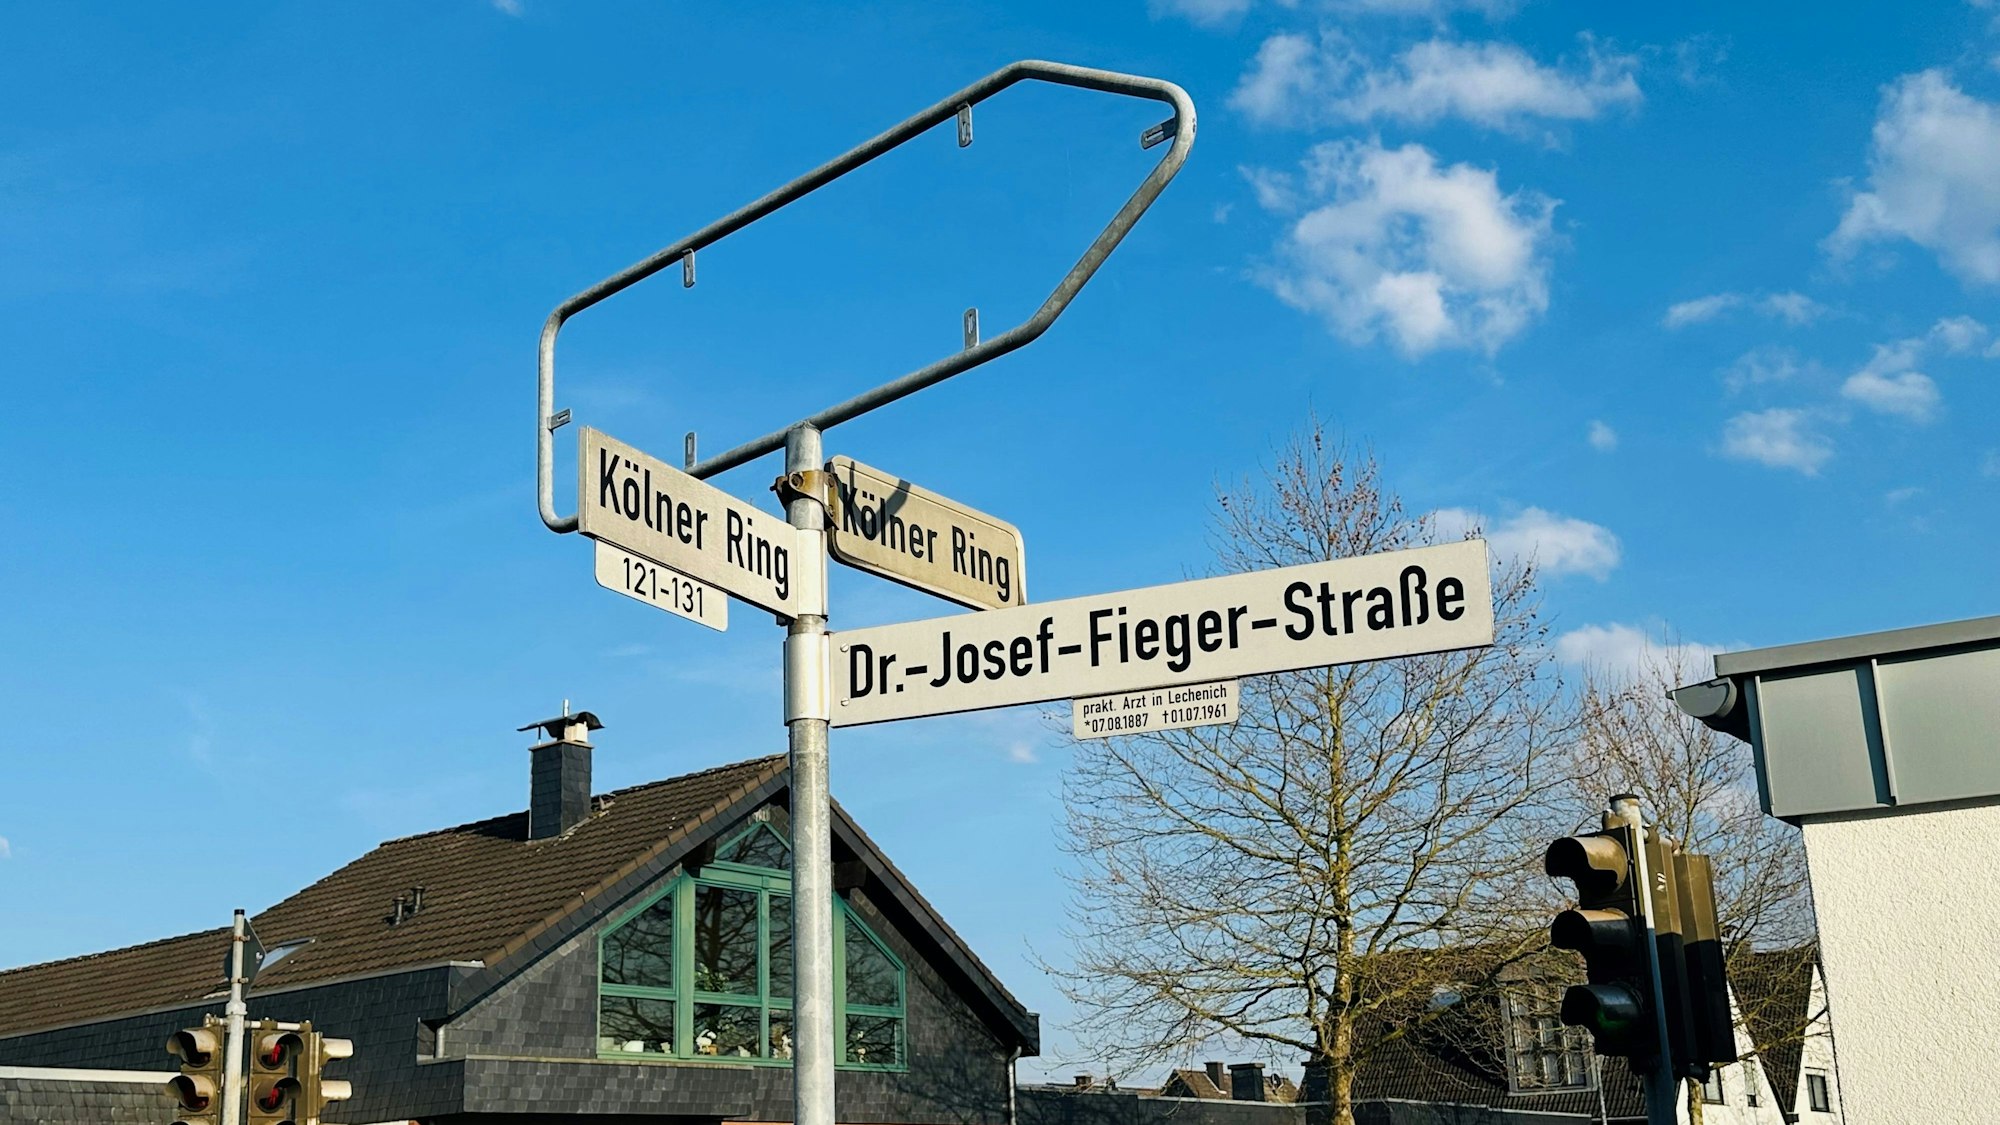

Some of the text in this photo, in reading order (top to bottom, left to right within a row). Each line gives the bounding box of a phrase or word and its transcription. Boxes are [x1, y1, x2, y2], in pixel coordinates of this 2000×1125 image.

[599, 448, 790, 601] Kölner Ring
[842, 482, 1011, 603] Kölner Ring
[623, 557, 703, 618] 121-131
[848, 564, 1466, 698] Dr.-Josef-Fieger-Straße
[1083, 684, 1227, 718] prakt. Arzt in Lechenich
